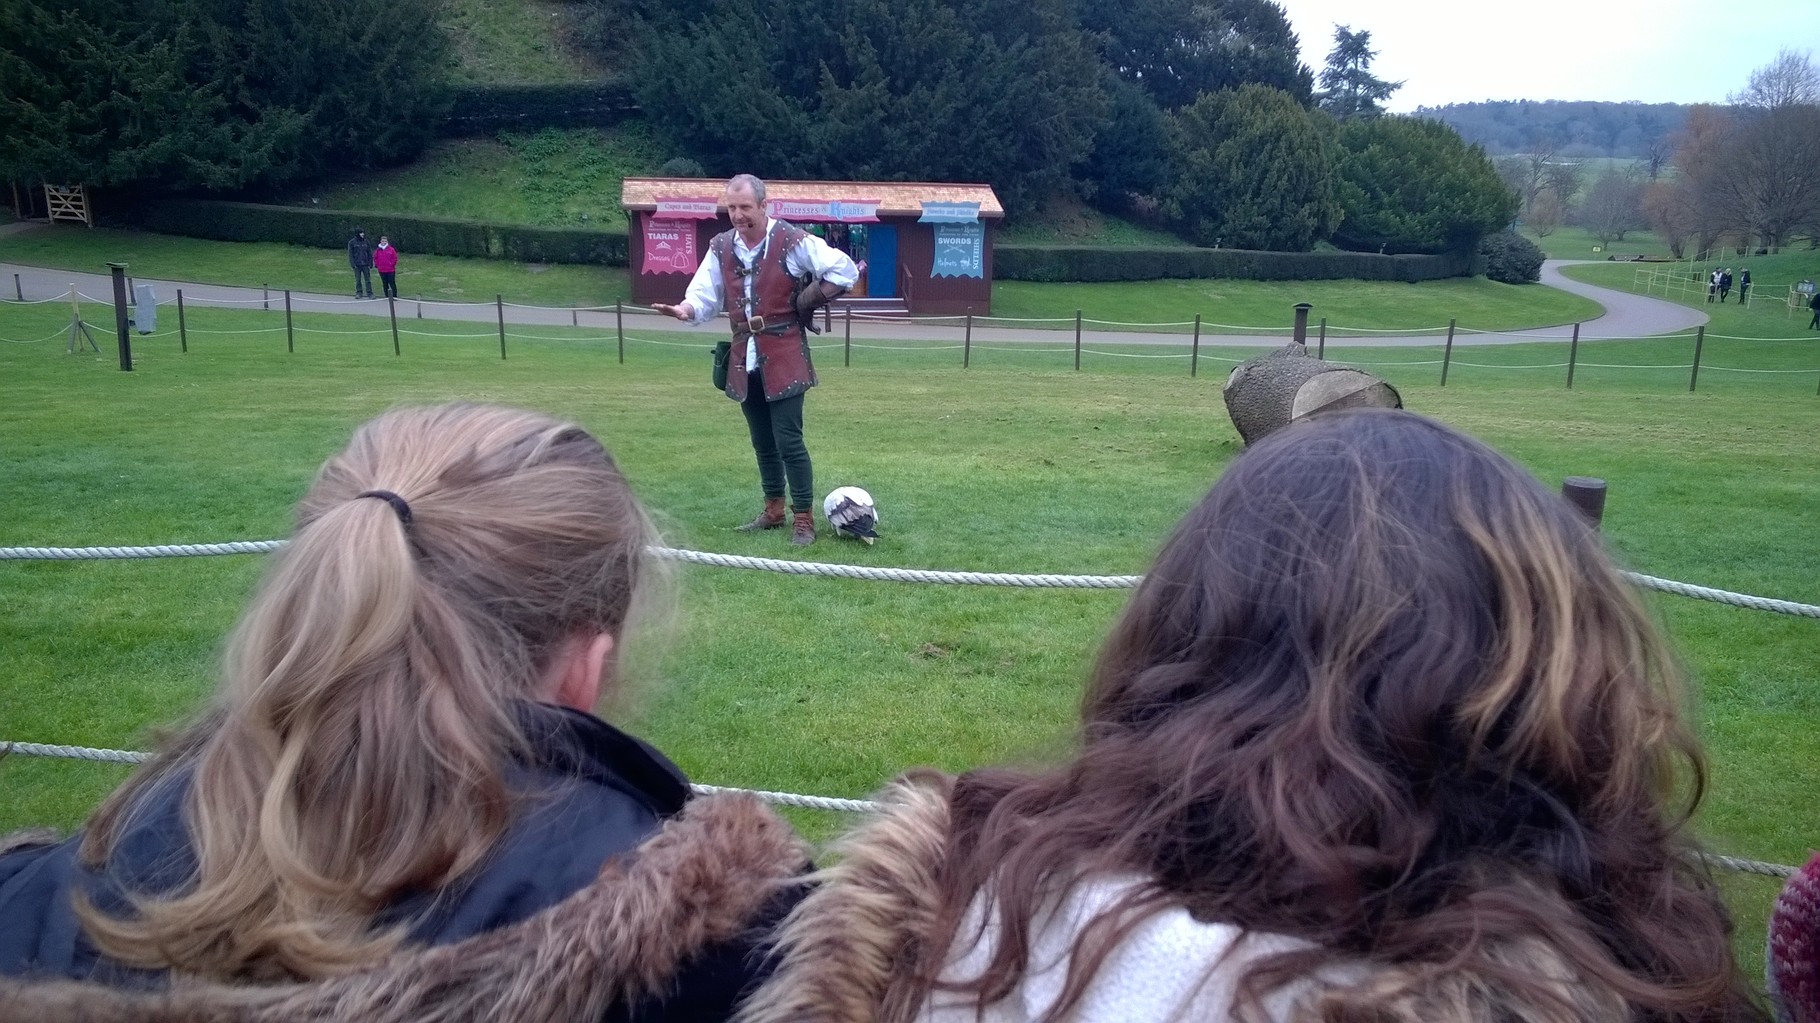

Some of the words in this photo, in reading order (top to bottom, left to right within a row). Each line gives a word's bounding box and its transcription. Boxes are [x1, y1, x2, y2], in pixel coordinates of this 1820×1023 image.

[772, 201, 819, 216] Princesses
[830, 201, 864, 219] Knights
[648, 252, 670, 262] Dresses
